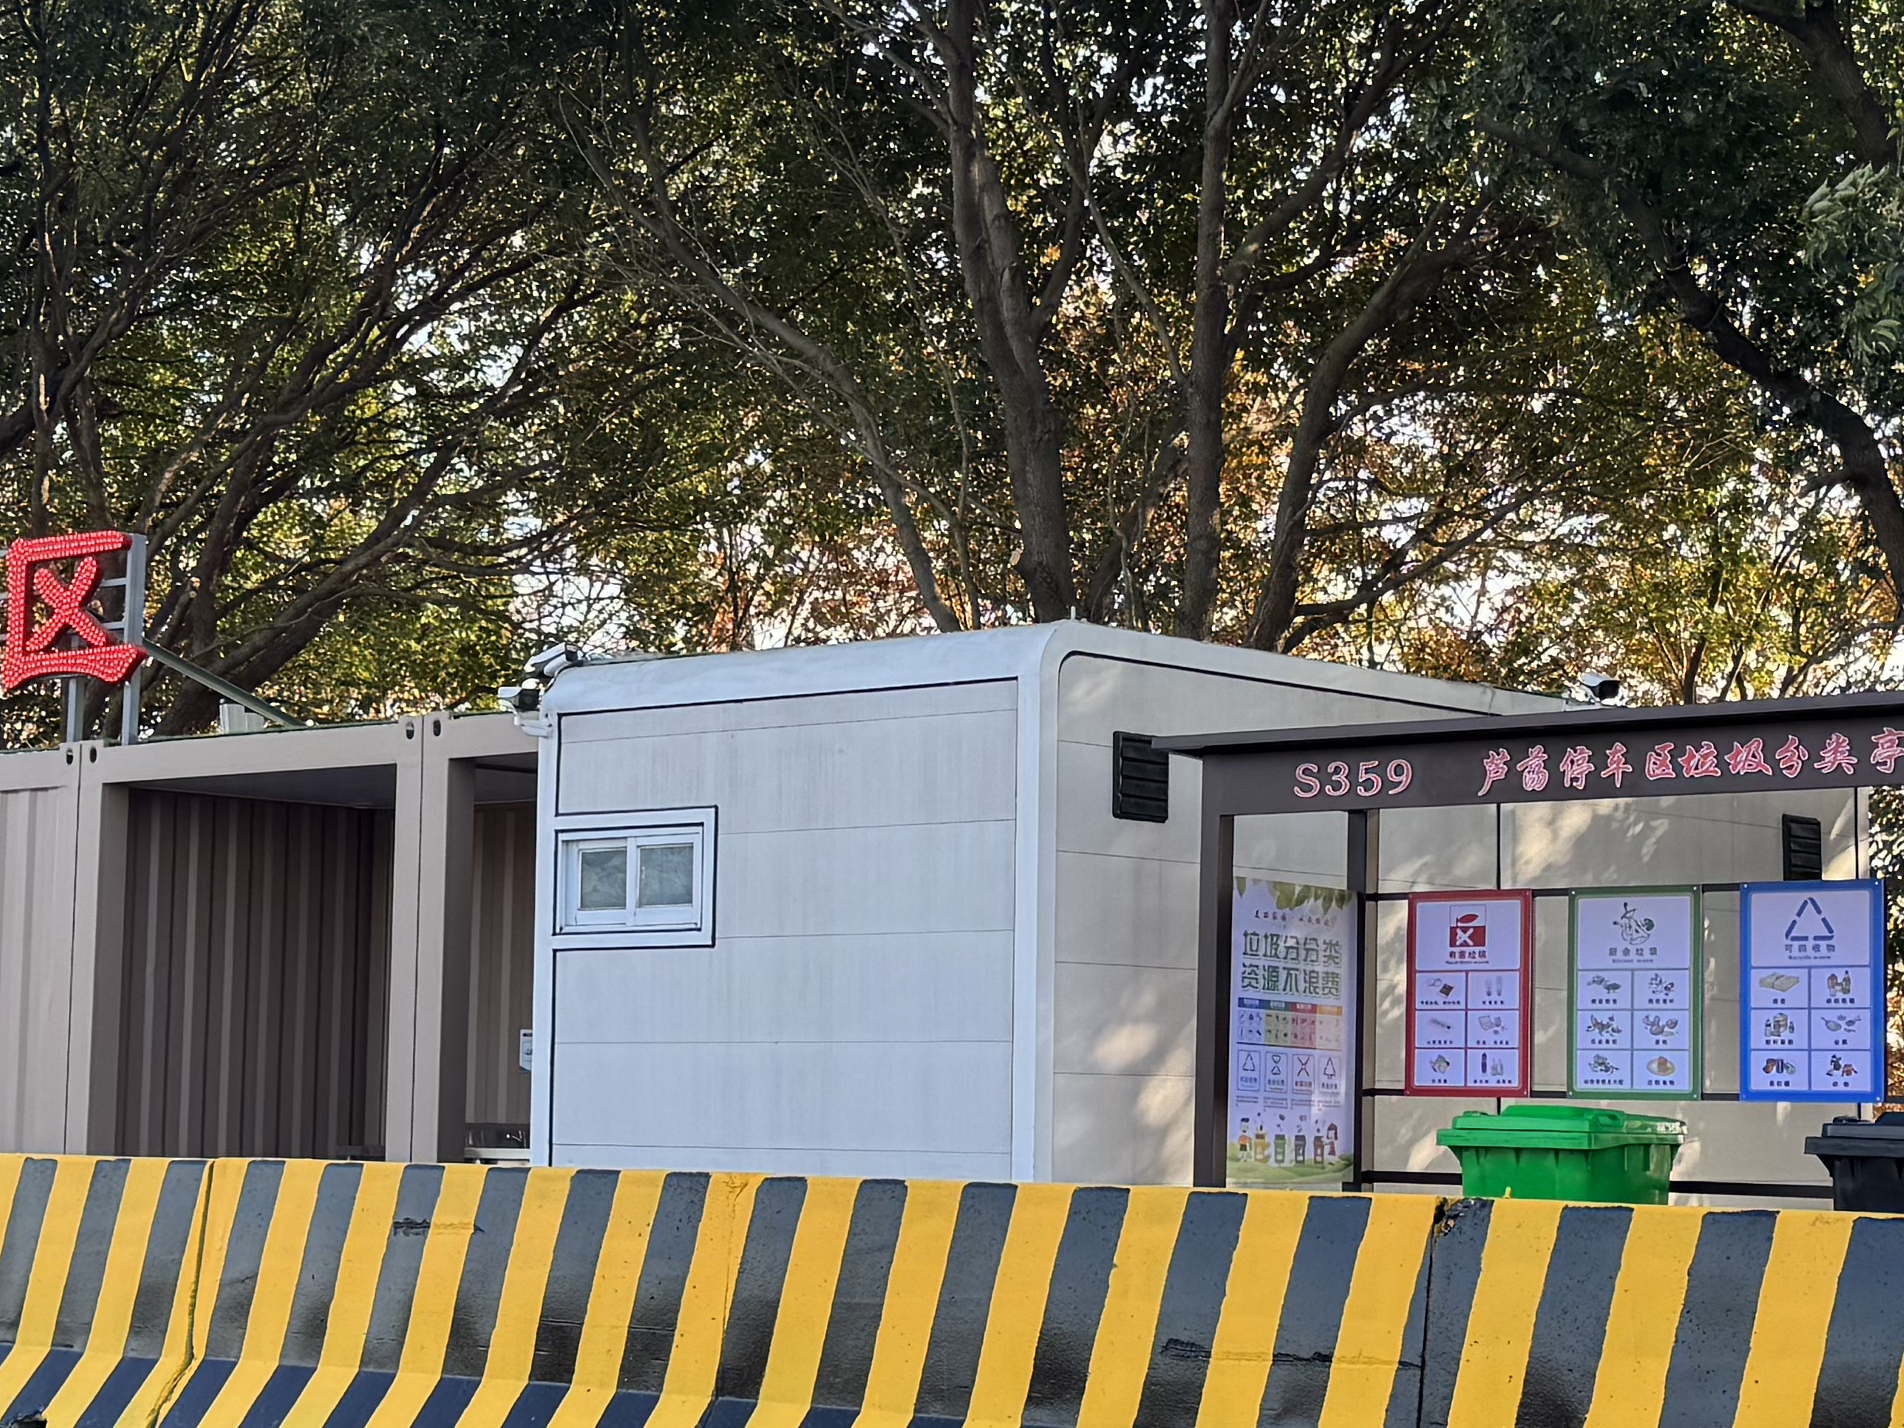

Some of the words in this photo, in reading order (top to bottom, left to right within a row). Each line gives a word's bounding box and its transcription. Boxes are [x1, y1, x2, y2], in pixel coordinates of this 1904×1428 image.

[1293, 759, 1413, 798] S359
[1242, 930, 1341, 967] 垃圾分分类
[1241, 962, 1341, 998] 资源不浪费
